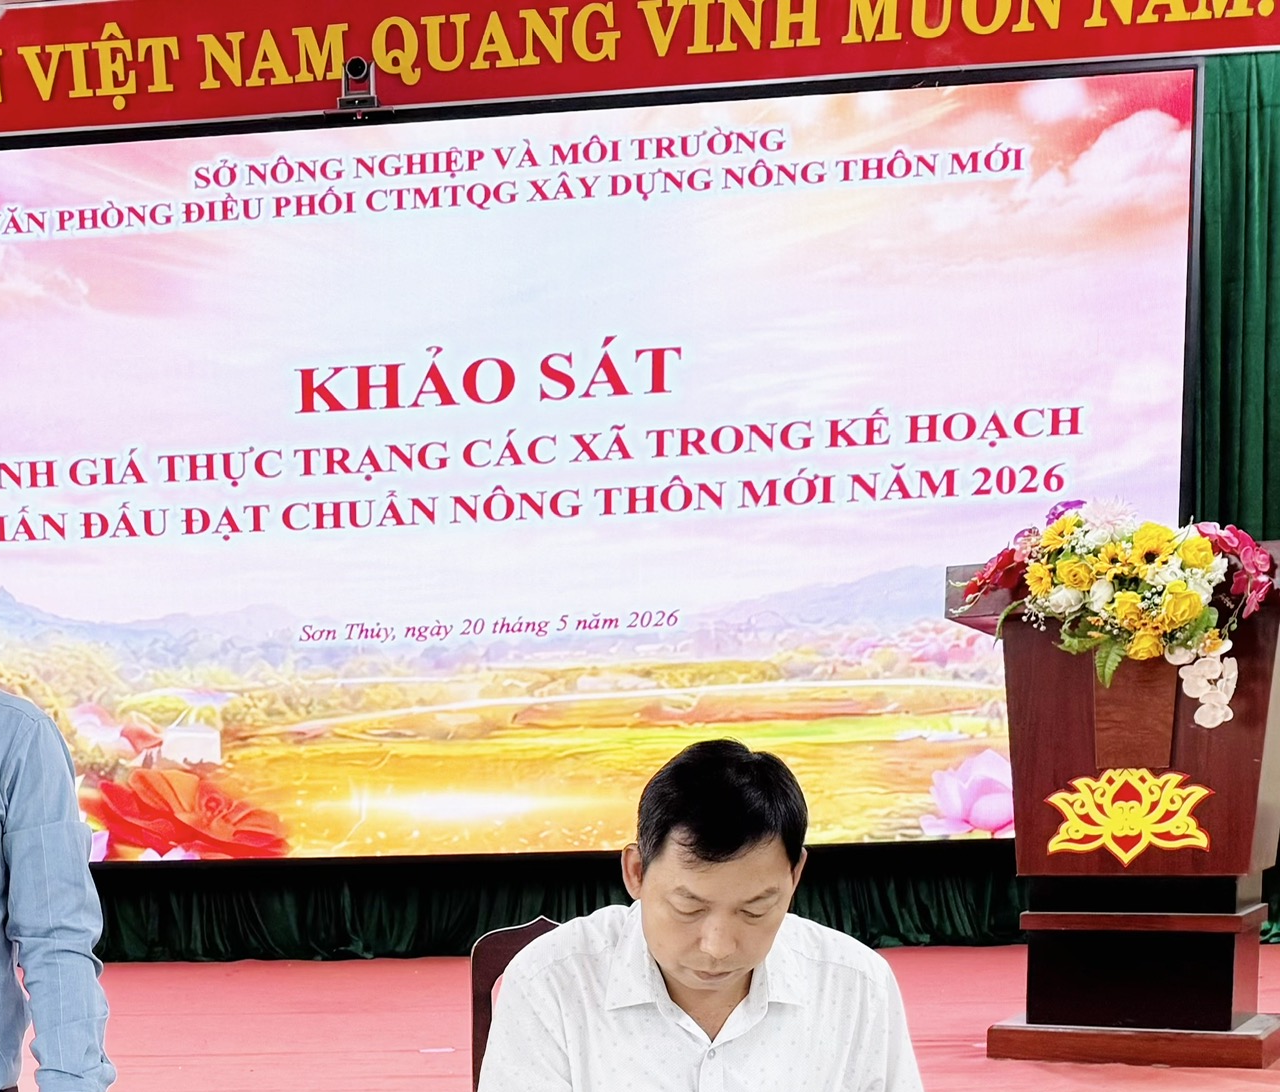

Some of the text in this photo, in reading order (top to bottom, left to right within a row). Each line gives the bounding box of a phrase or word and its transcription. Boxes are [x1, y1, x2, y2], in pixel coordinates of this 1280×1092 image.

[18, 23, 179, 110] VIỆT
[197, 24, 348, 89] NAM
[372, 2, 620, 85] QUANG
[639, 0, 820, 56] VINH
[59, 202, 171, 230] PHÒNG
[183, 193, 262, 223] ĐIỀU
[275, 187, 353, 217] PHỐI
[366, 182, 516, 211] CTMTQG
[530, 172, 598, 201] XÂY
[611, 169, 710, 200] DỰNG
[725, 160, 824, 187] NÔNG
[836, 150, 936, 181] THÔN
[952, 144, 1022, 172] MỚI
[195, 128, 783, 187] SỞ NÔNG NGHIỆP VÀ MÔI TRƯỜNG
[298, 336, 681, 413] KHẢO SÁT
[69, 449, 145, 485] GIÁ
[159, 447, 281, 487] THỰC
[294, 443, 447, 481] TRẠNG
[463, 429, 556, 467] CÁC
[573, 425, 632, 461] XÃ
[647, 422, 811, 457] TRONG
[829, 409, 889, 447] KẾ
[908, 407, 1080, 447] HOẠCH
[84, 503, 166, 538] ĐẤU
[185, 506, 269, 541] ĐẠT
[282, 491, 435, 530] CHUẨN
[453, 486, 579, 523] NÔNG
[594, 476, 723, 515] THÔN
[741, 468, 831, 507] MỚI
[850, 464, 955, 501] NĂM
[972, 464, 1064, 495] 2026
[299, 609, 680, 643] Sơn Thủy, ngày 20 tháng 5 năm 2026
